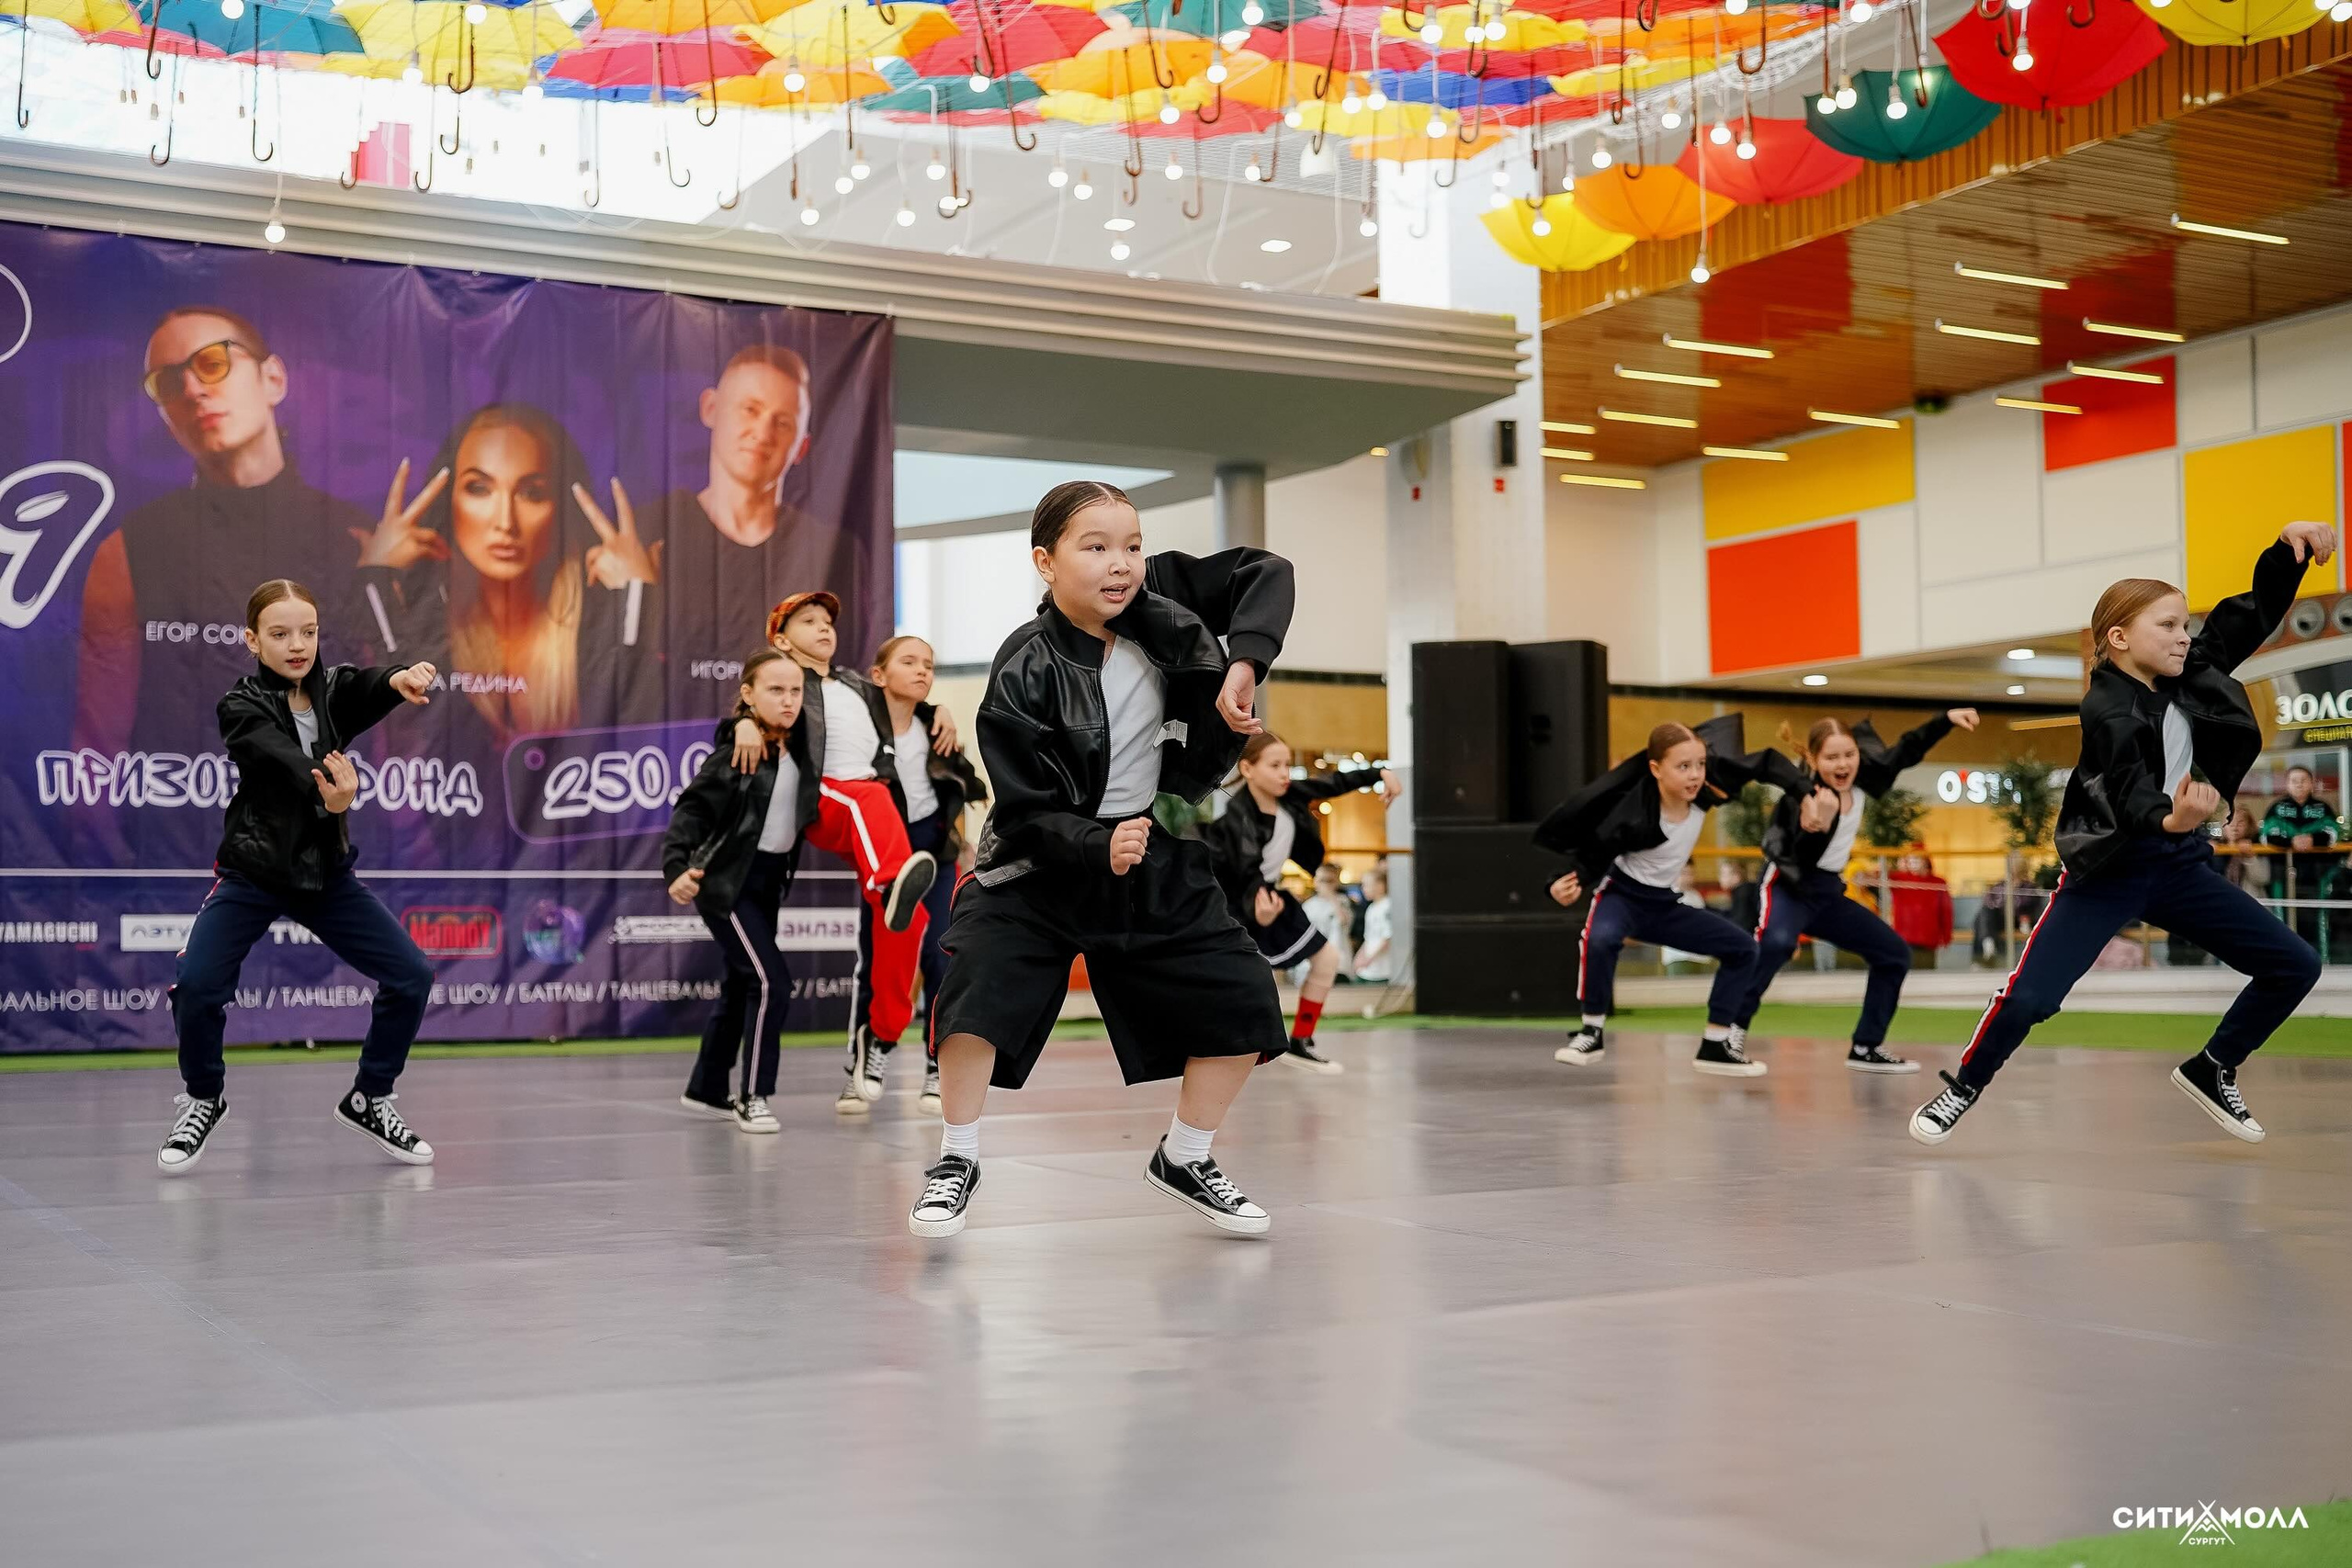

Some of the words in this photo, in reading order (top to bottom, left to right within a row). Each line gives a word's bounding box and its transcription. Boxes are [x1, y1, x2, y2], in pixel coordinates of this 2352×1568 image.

[145, 621, 199, 643] ЕГОР
[449, 671, 528, 694] РЕДИНА
[267, 920, 323, 945] TW
[0, 988, 99, 1012] АЛЬНОЕ
[103, 987, 161, 1010] ШОУ
[448, 982, 502, 1005] ШОУ
[518, 981, 594, 1004] БАТТЛЫ
